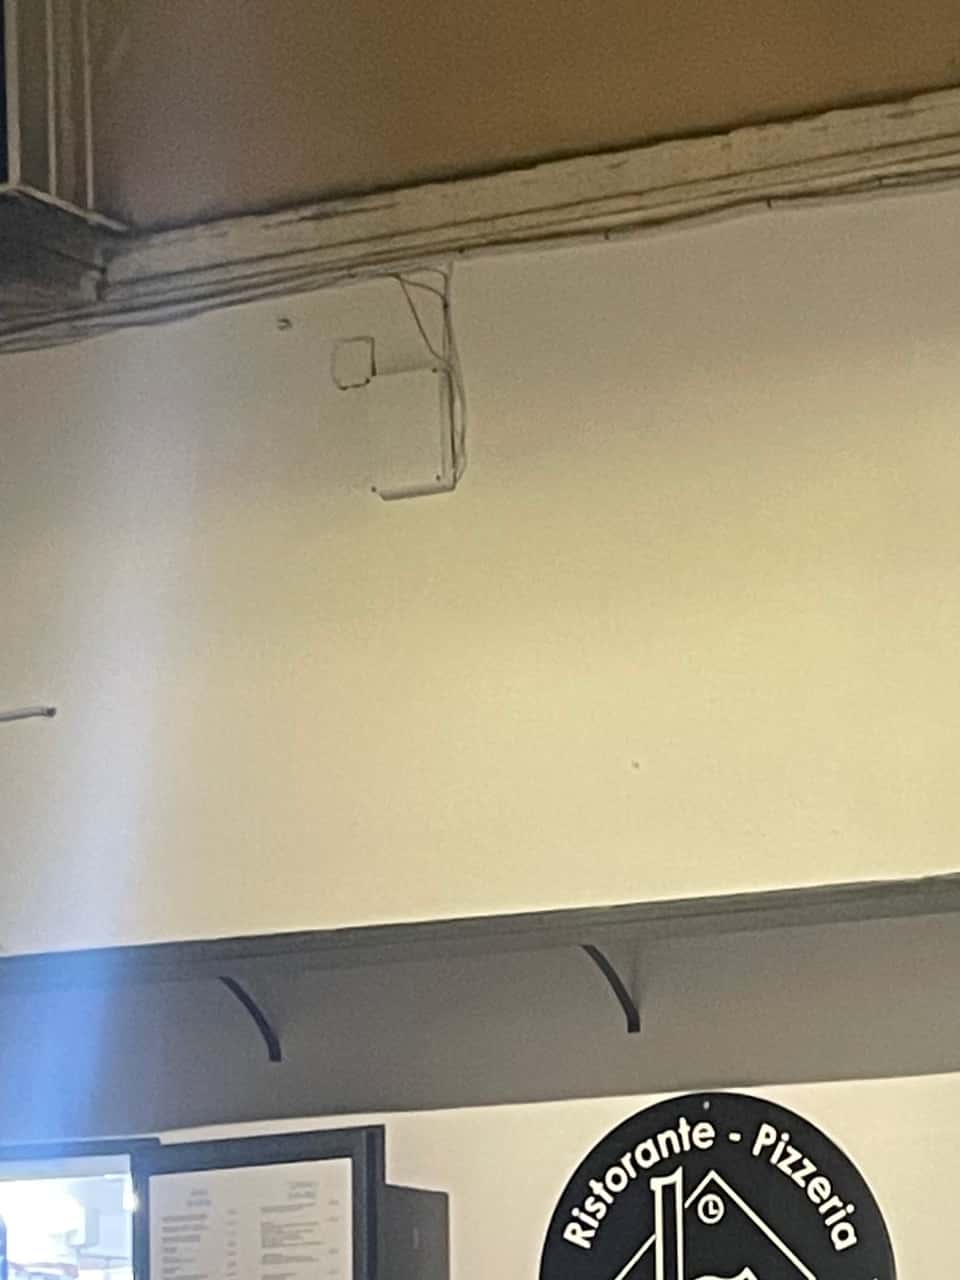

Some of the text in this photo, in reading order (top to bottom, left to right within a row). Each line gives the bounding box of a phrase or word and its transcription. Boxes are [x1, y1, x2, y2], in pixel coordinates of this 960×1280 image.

[562, 1116, 858, 1252] Ristorante - Pizzeria
